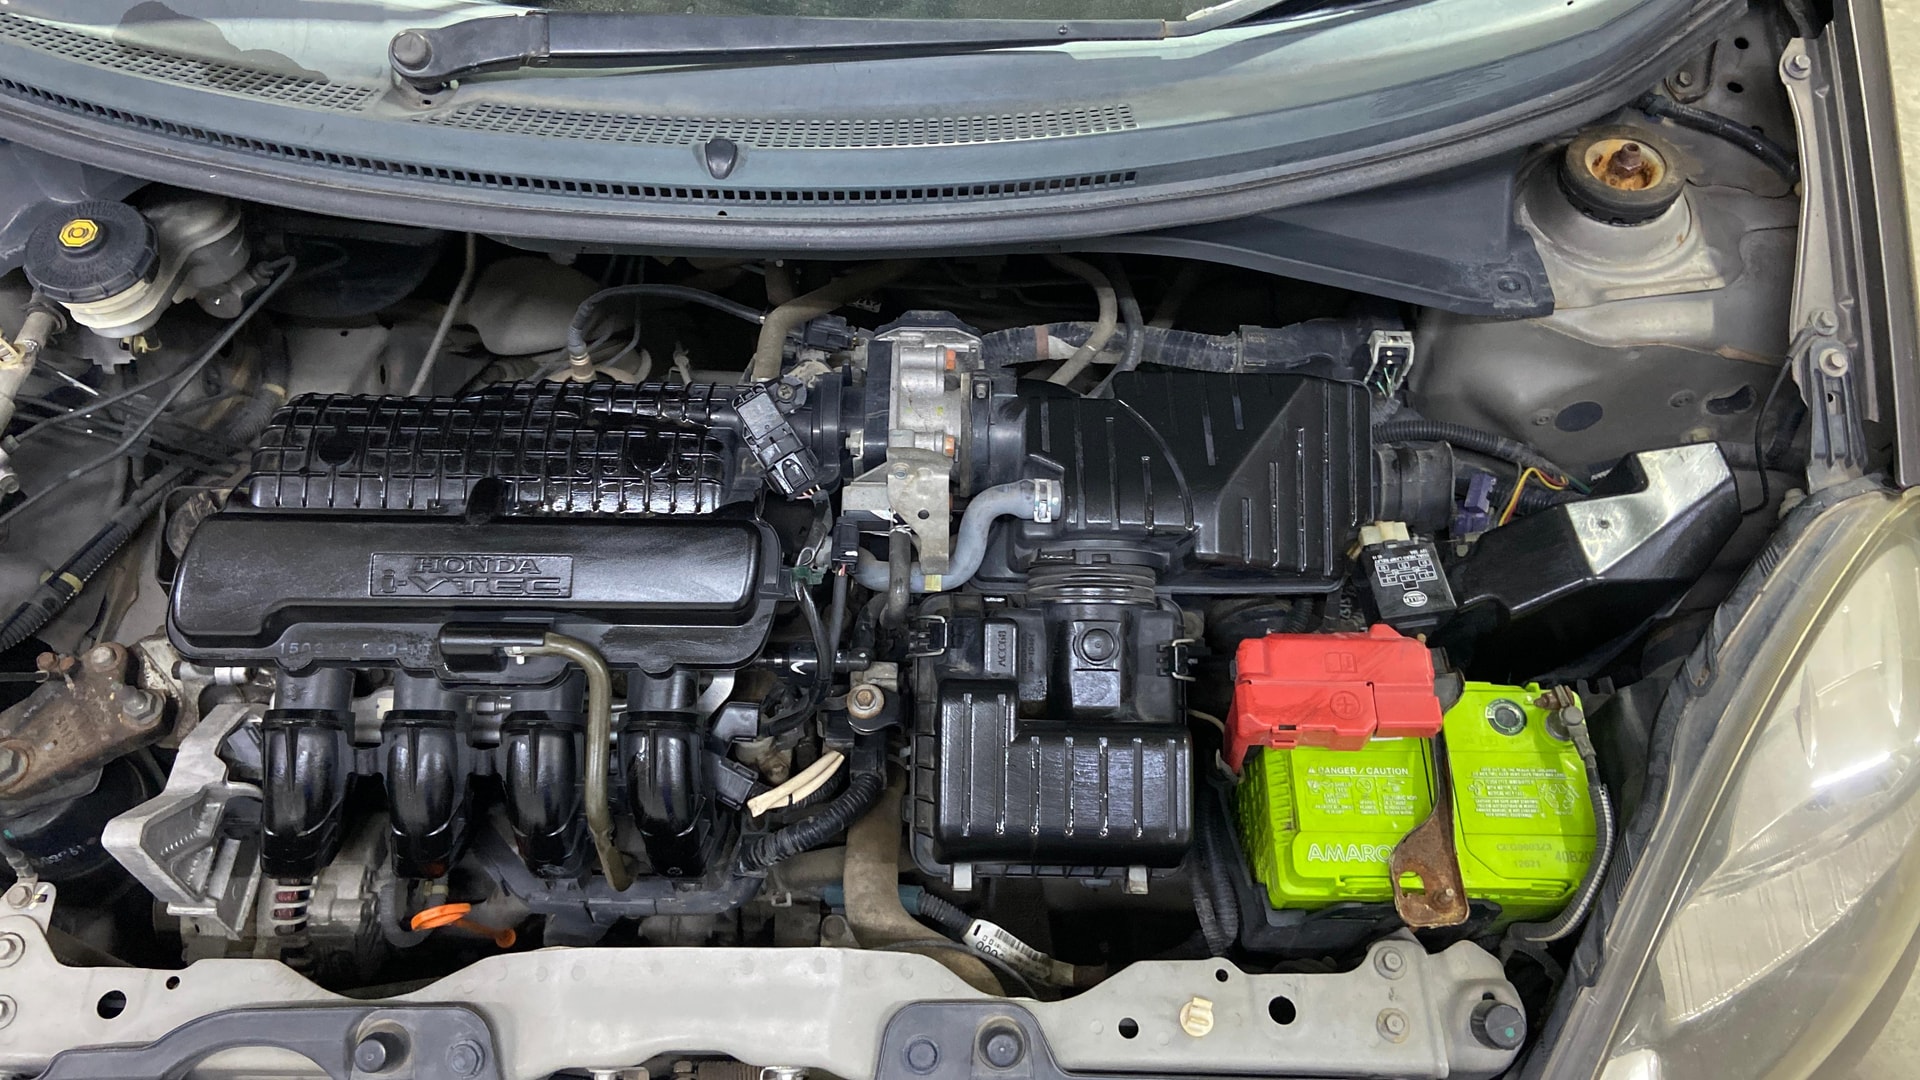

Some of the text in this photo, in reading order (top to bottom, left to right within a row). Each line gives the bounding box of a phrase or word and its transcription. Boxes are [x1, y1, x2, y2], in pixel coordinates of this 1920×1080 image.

[414, 556, 541, 575] HONDA
[380, 569, 562, 594] i-VTEC
[1318, 766, 1357, 775] DANGER
[1366, 767, 1409, 775] CAUTION
[1307, 843, 1396, 863] AMARO
[1555, 850, 1594, 864] 40B20
